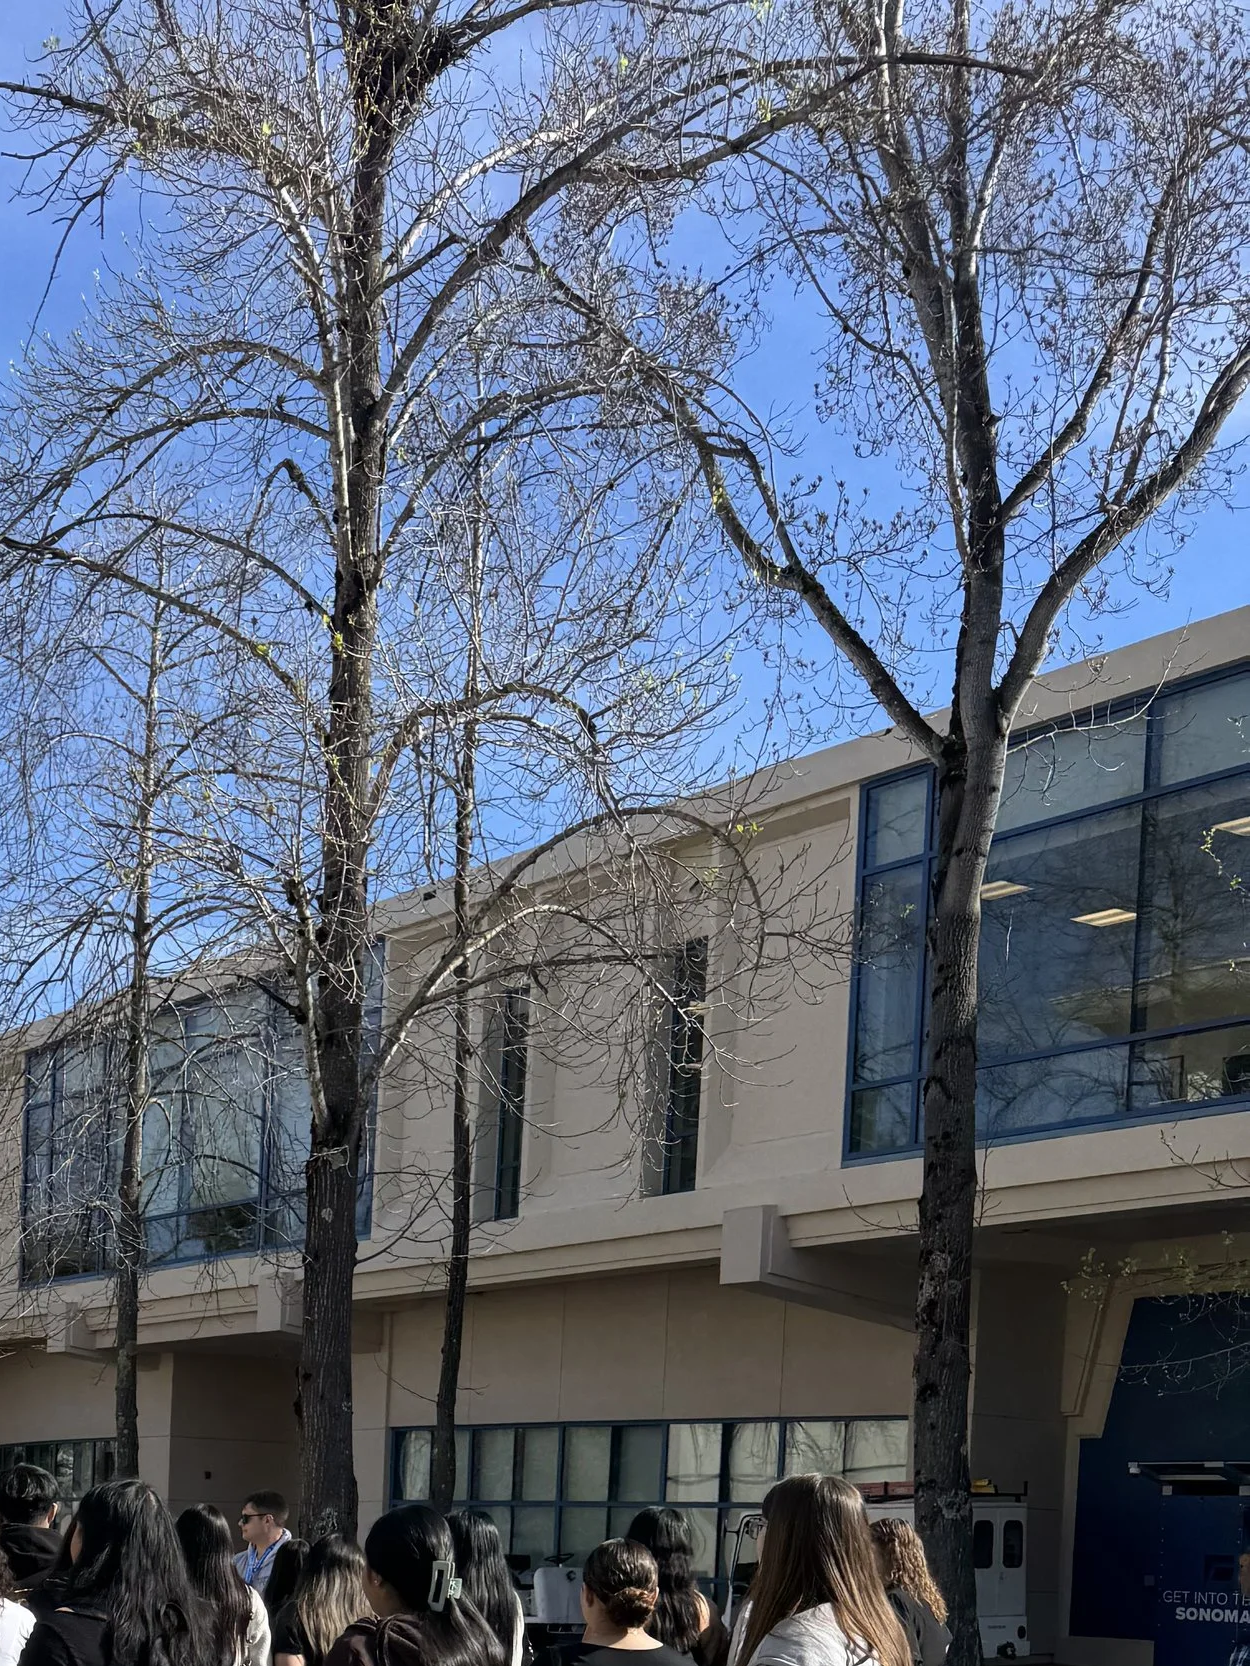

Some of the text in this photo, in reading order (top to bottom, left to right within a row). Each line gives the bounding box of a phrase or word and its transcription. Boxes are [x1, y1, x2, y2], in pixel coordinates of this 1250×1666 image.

[1163, 1590, 1190, 1604] GET
[1194, 1592, 1228, 1605] INTO
[1175, 1607, 1250, 1623] SONOMA
